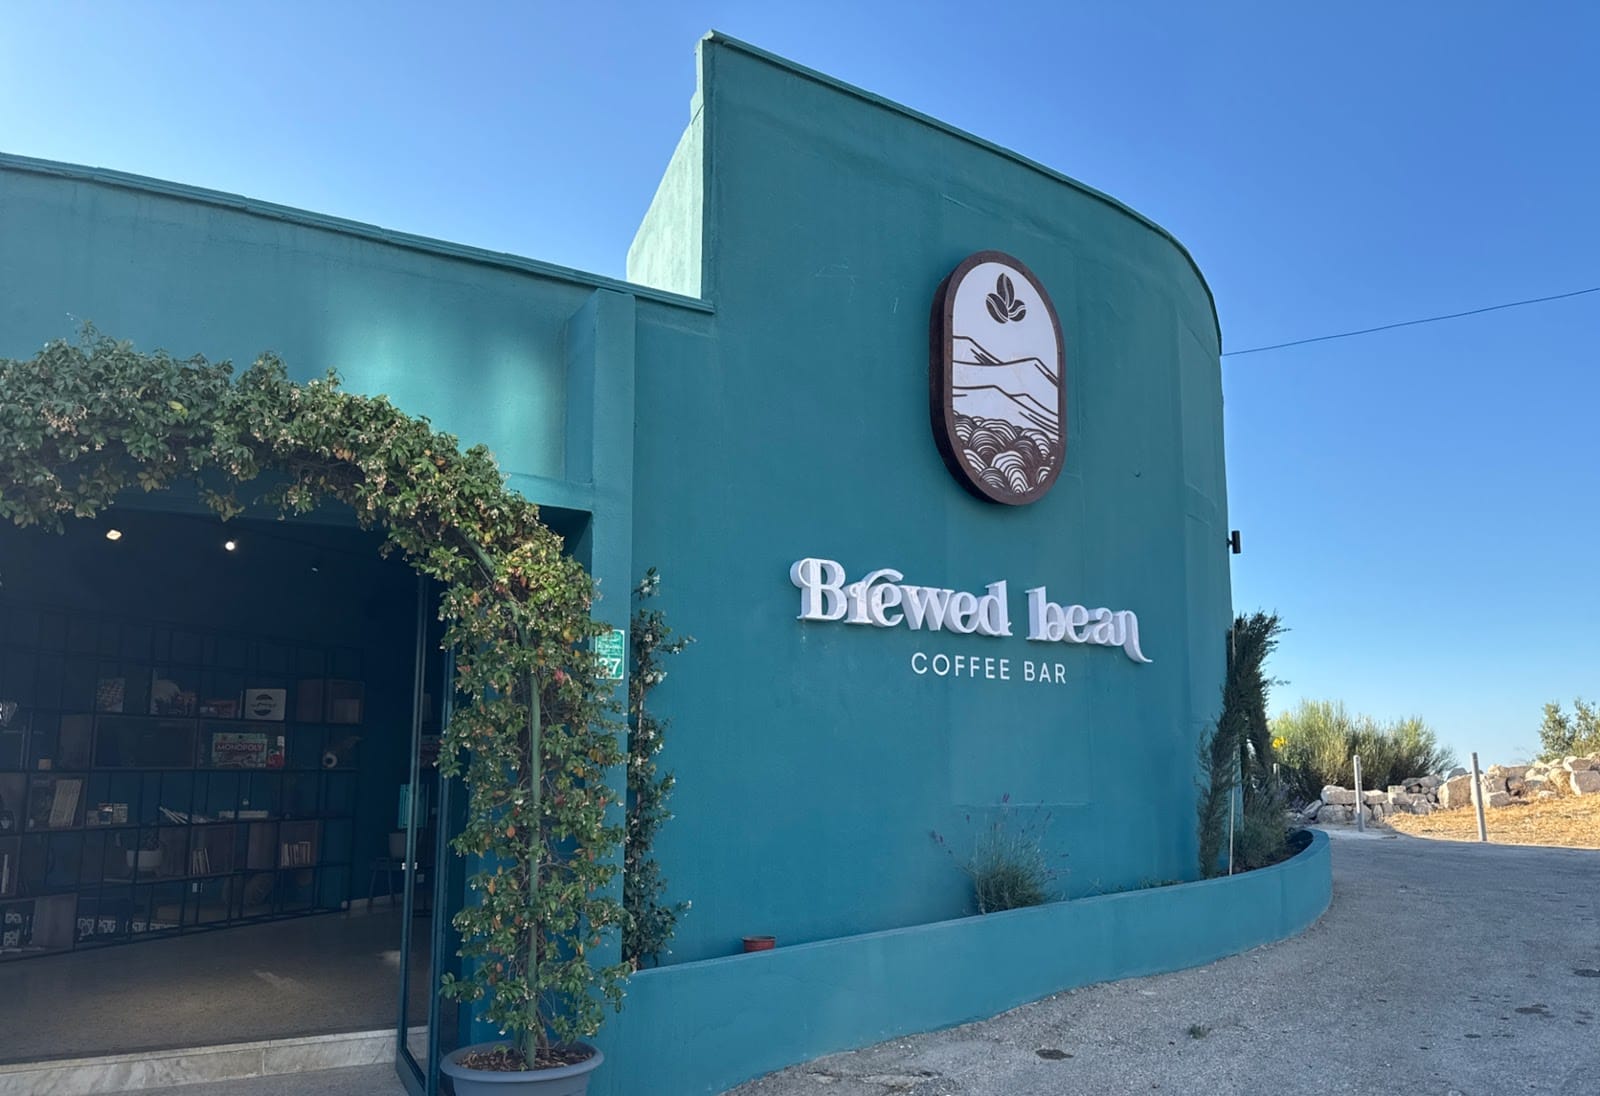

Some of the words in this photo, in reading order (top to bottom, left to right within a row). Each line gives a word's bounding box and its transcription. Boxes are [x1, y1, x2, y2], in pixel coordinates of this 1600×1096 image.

[790, 557, 1013, 637] Brewed
[1025, 586, 1152, 664] bean
[911, 652, 1011, 680] COFFEE
[1024, 660, 1066, 684] BAR
[216, 743, 263, 752] MONOPOLY
